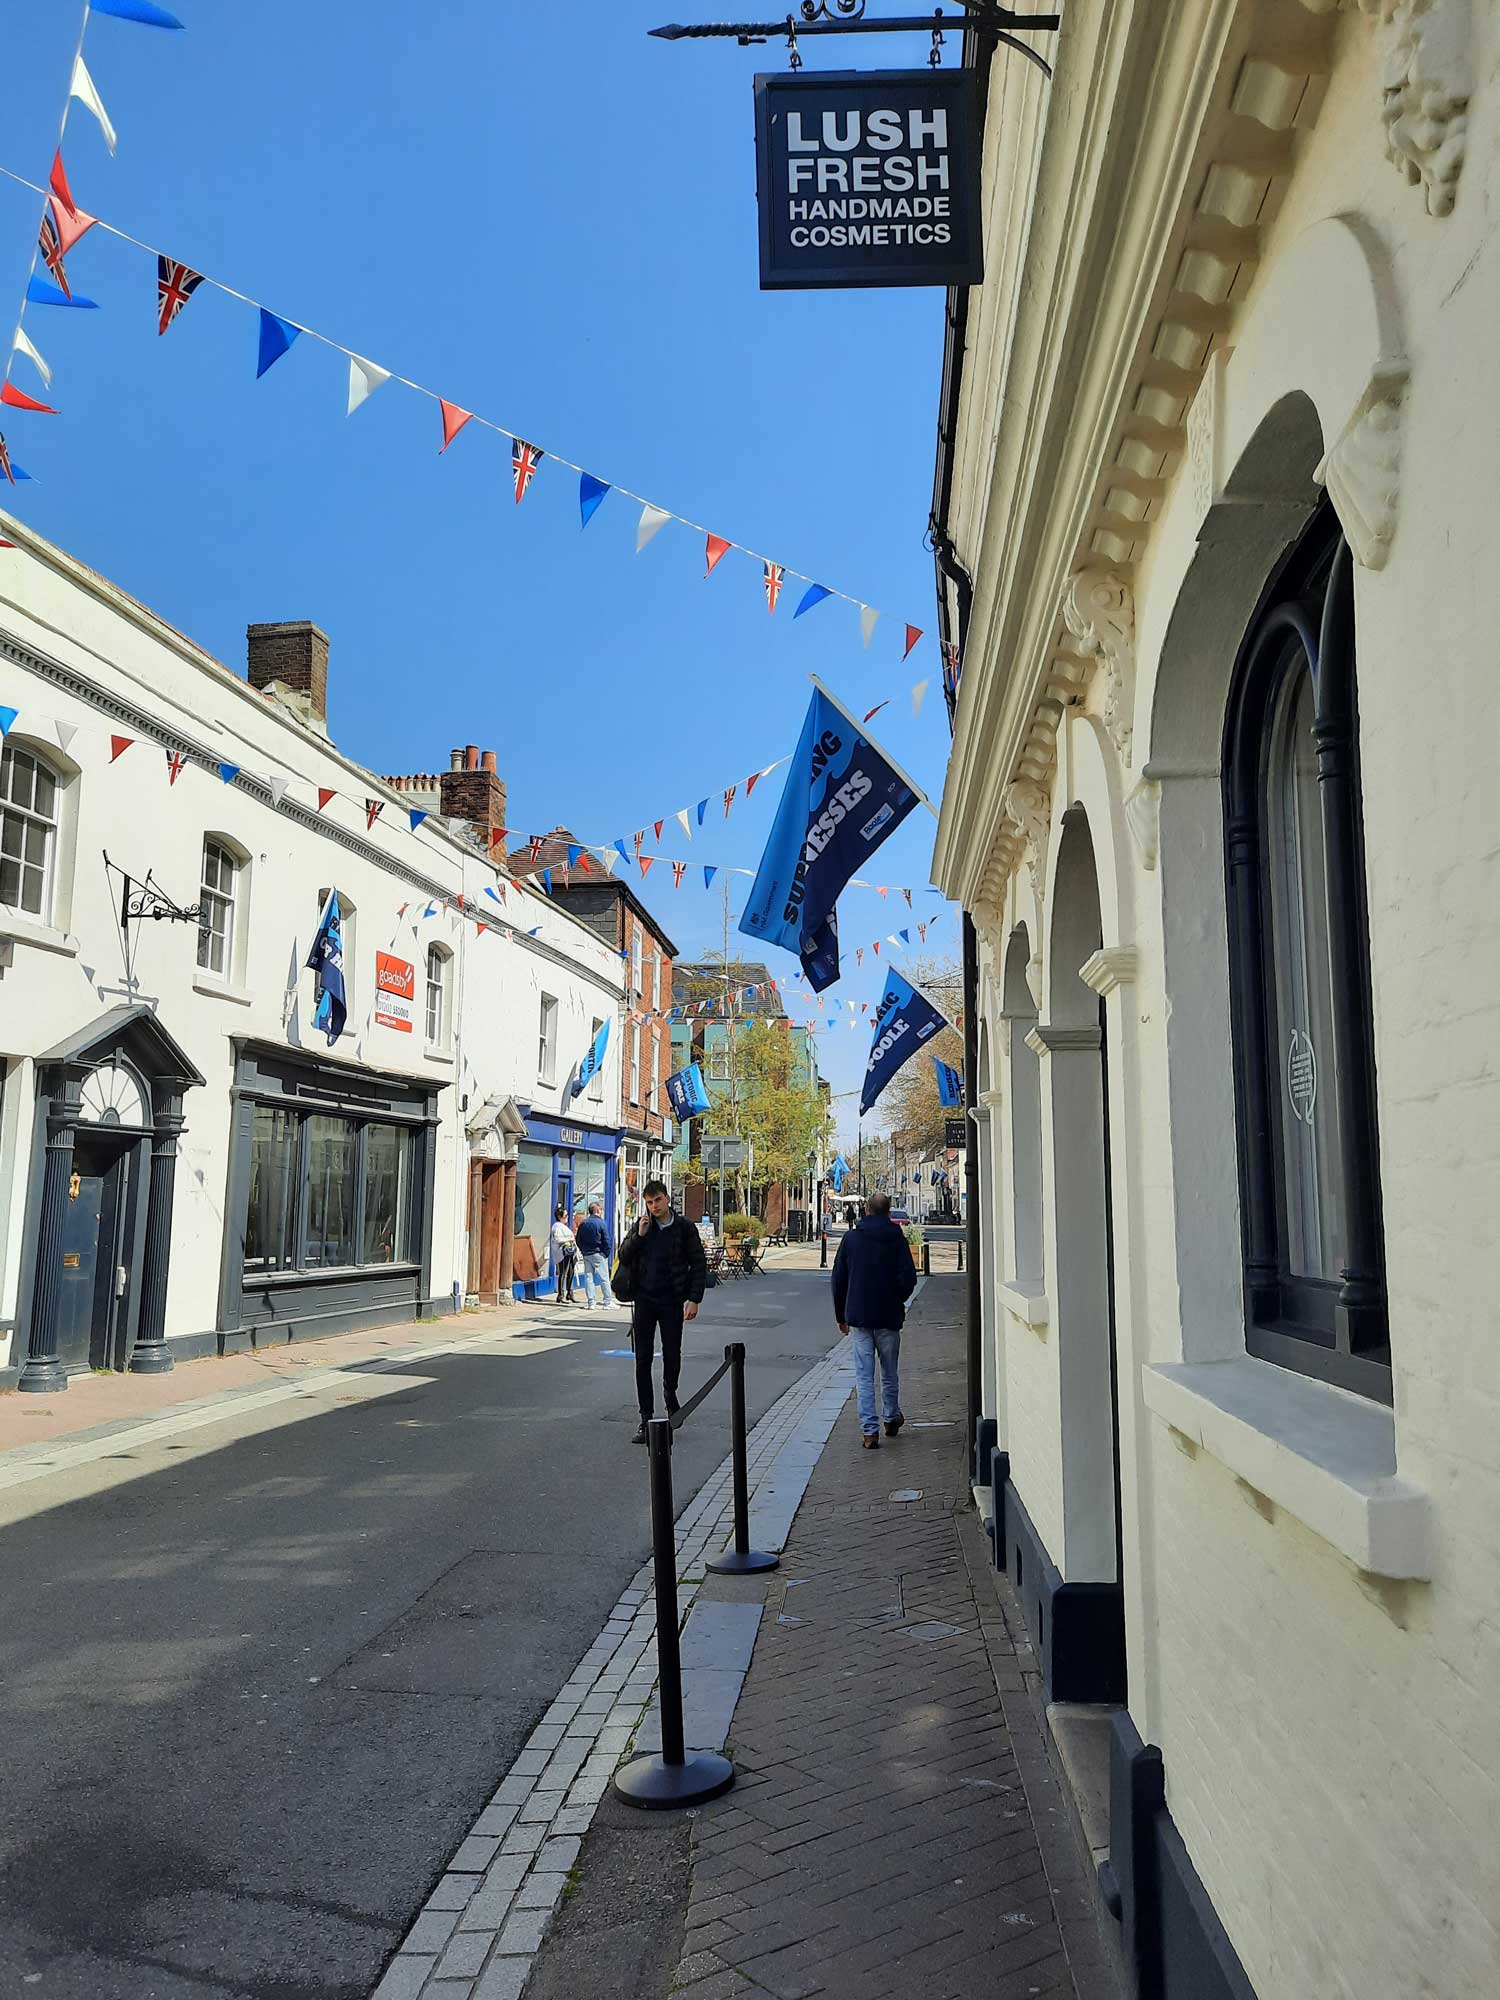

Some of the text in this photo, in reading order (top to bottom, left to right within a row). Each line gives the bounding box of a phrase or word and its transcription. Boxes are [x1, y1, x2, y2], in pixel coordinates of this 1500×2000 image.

[786, 108, 948, 152] LUSH
[788, 155, 950, 194] FRESH
[789, 196, 951, 221] HANDMADE
[790, 223, 952, 248] COSMETICS
[379, 968, 408, 992] goadsby
[867, 1018, 910, 1072] POOLE
[674, 1080, 685, 1104] POOLE
[560, 1127, 583, 1144] GALLERY
